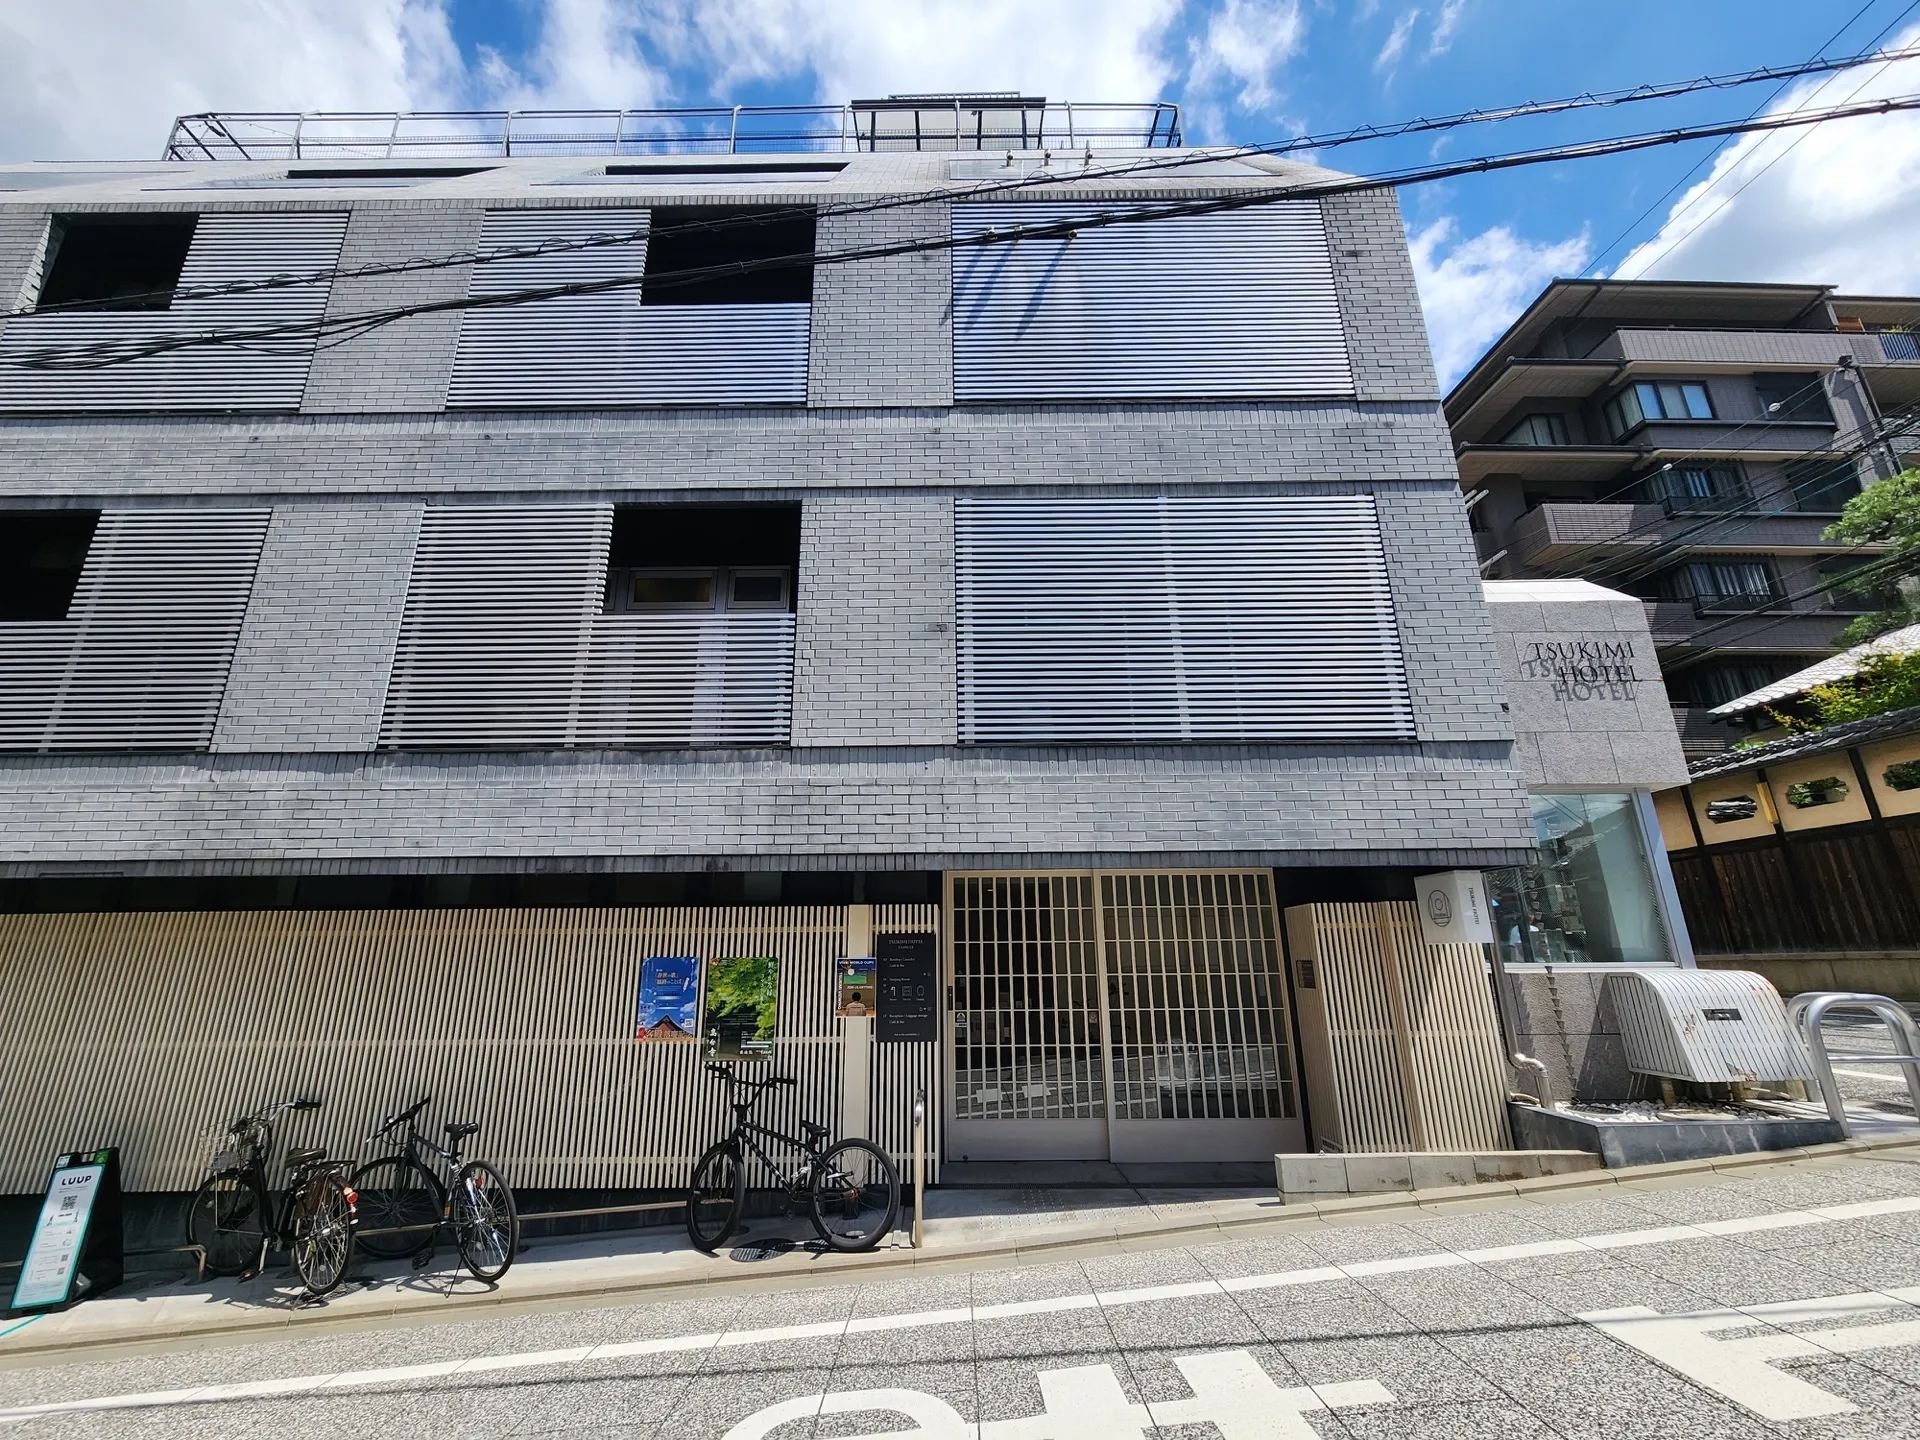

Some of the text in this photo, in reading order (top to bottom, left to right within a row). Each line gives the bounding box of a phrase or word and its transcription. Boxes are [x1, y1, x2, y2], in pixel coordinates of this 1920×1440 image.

[1529, 641, 1635, 660] TSUKIMI
[1558, 665, 1642, 683] HOTEL
[1468, 887, 1480, 925] TSUKIMI HOTEL
[708, 1028, 717, 1057] 高台寺
[61, 1175, 92, 1186] LUUP
